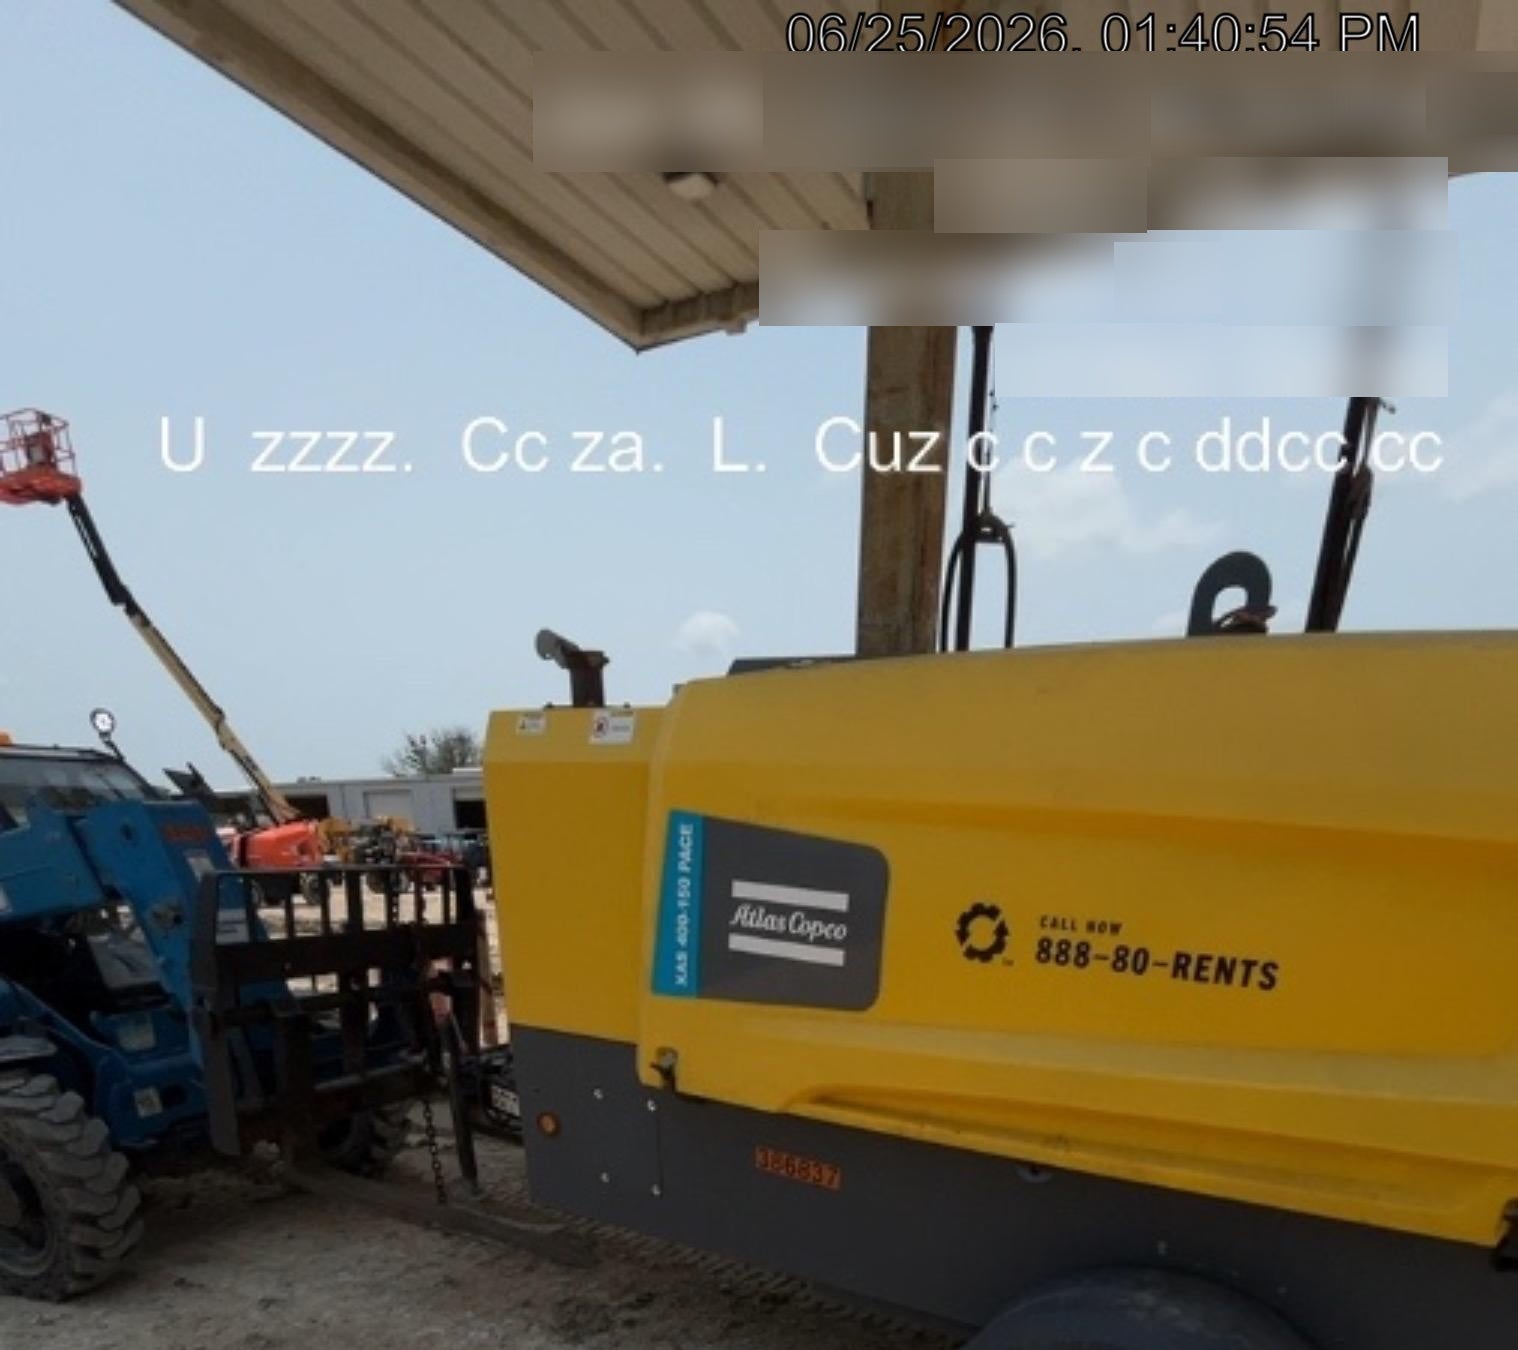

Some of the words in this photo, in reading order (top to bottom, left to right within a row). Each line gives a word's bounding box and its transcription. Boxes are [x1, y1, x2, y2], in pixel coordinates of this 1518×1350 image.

[678, 822, 695, 874] PACE
[730, 904, 786, 931] Atlas
[788, 912, 848, 942] Copco
[1039, 914, 1077, 931] CALL
[1086, 920, 1123, 935] NOW
[675, 951, 690, 987] XAS
[1035, 936, 1279, 991] 888-80-RENTS
